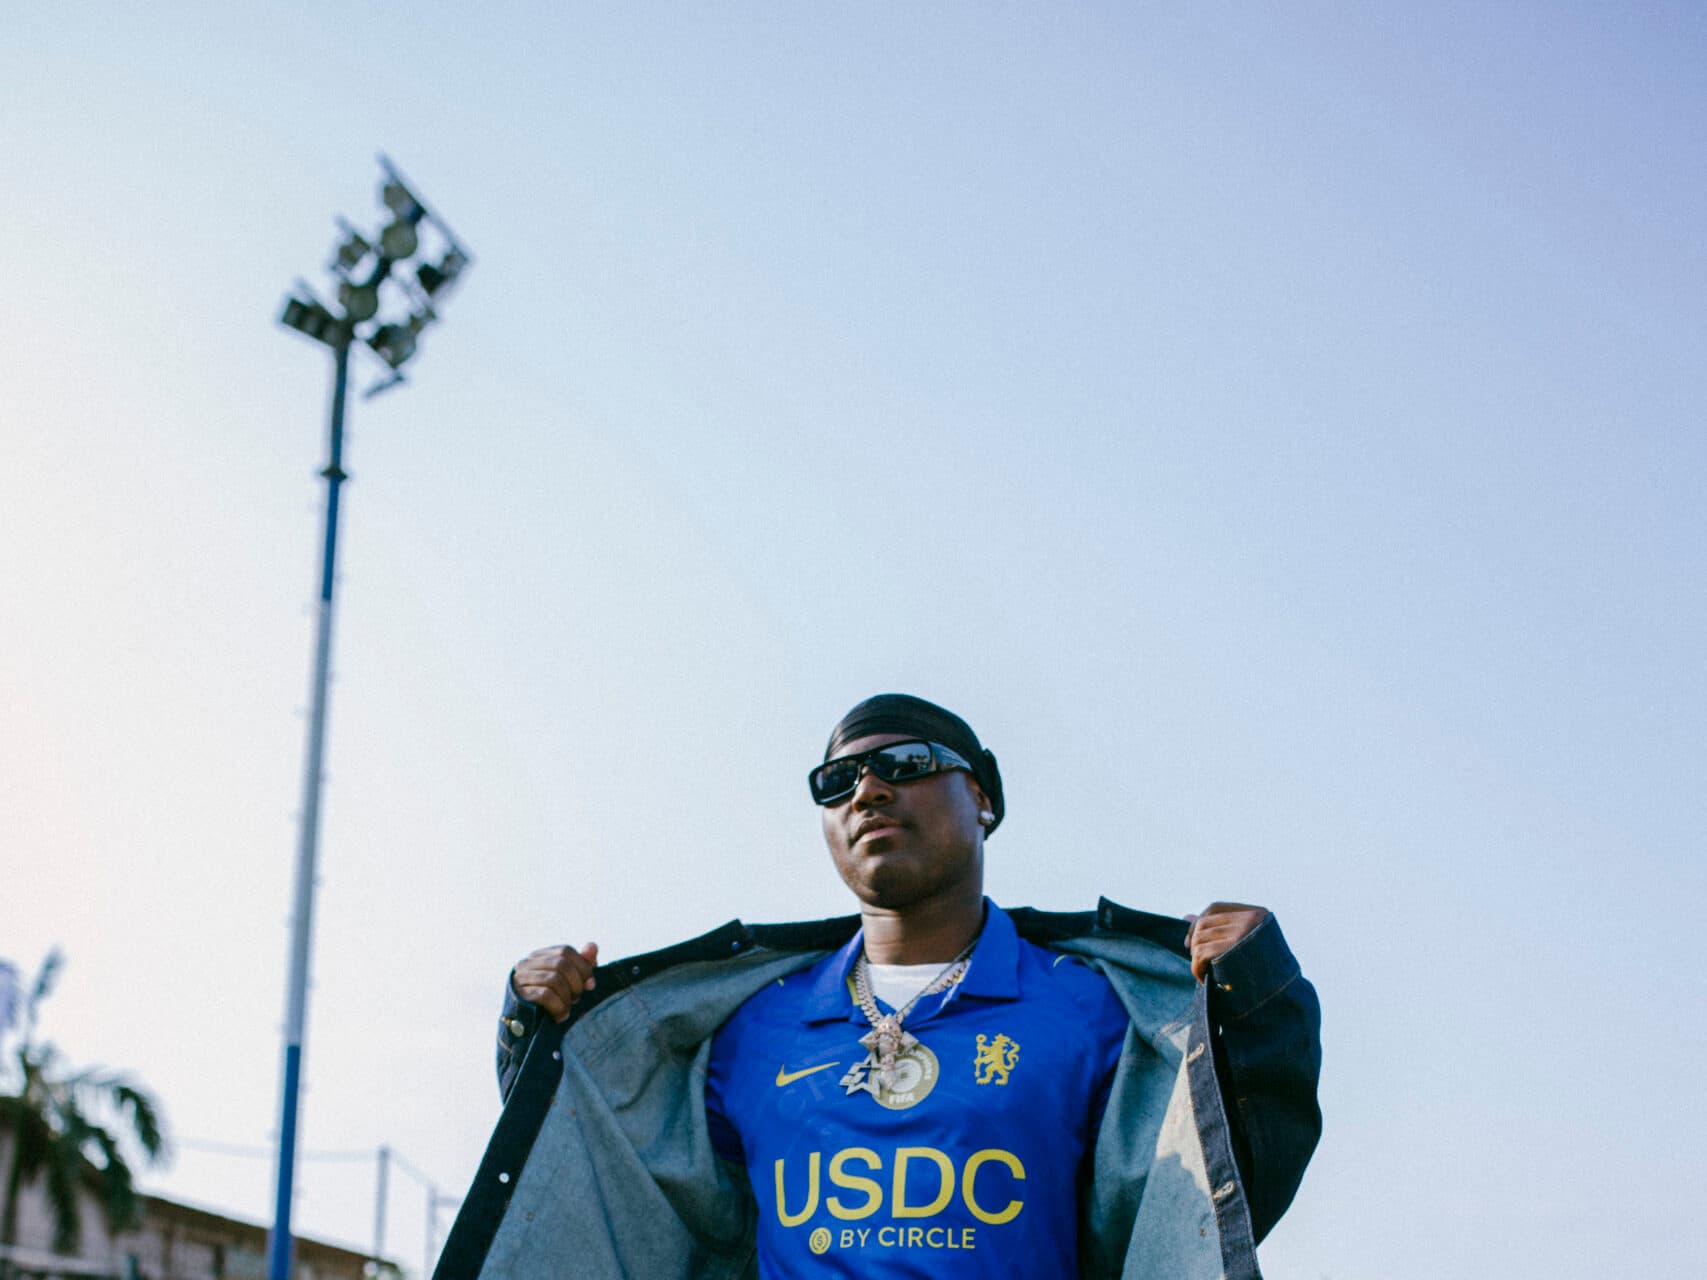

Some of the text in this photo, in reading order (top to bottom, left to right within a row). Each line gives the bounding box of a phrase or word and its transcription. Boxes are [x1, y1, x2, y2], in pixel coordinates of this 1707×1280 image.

[888, 1092, 915, 1105] FIFA
[775, 1147, 1026, 1227] USDC
[839, 1226, 976, 1249] BY CIRCLE
